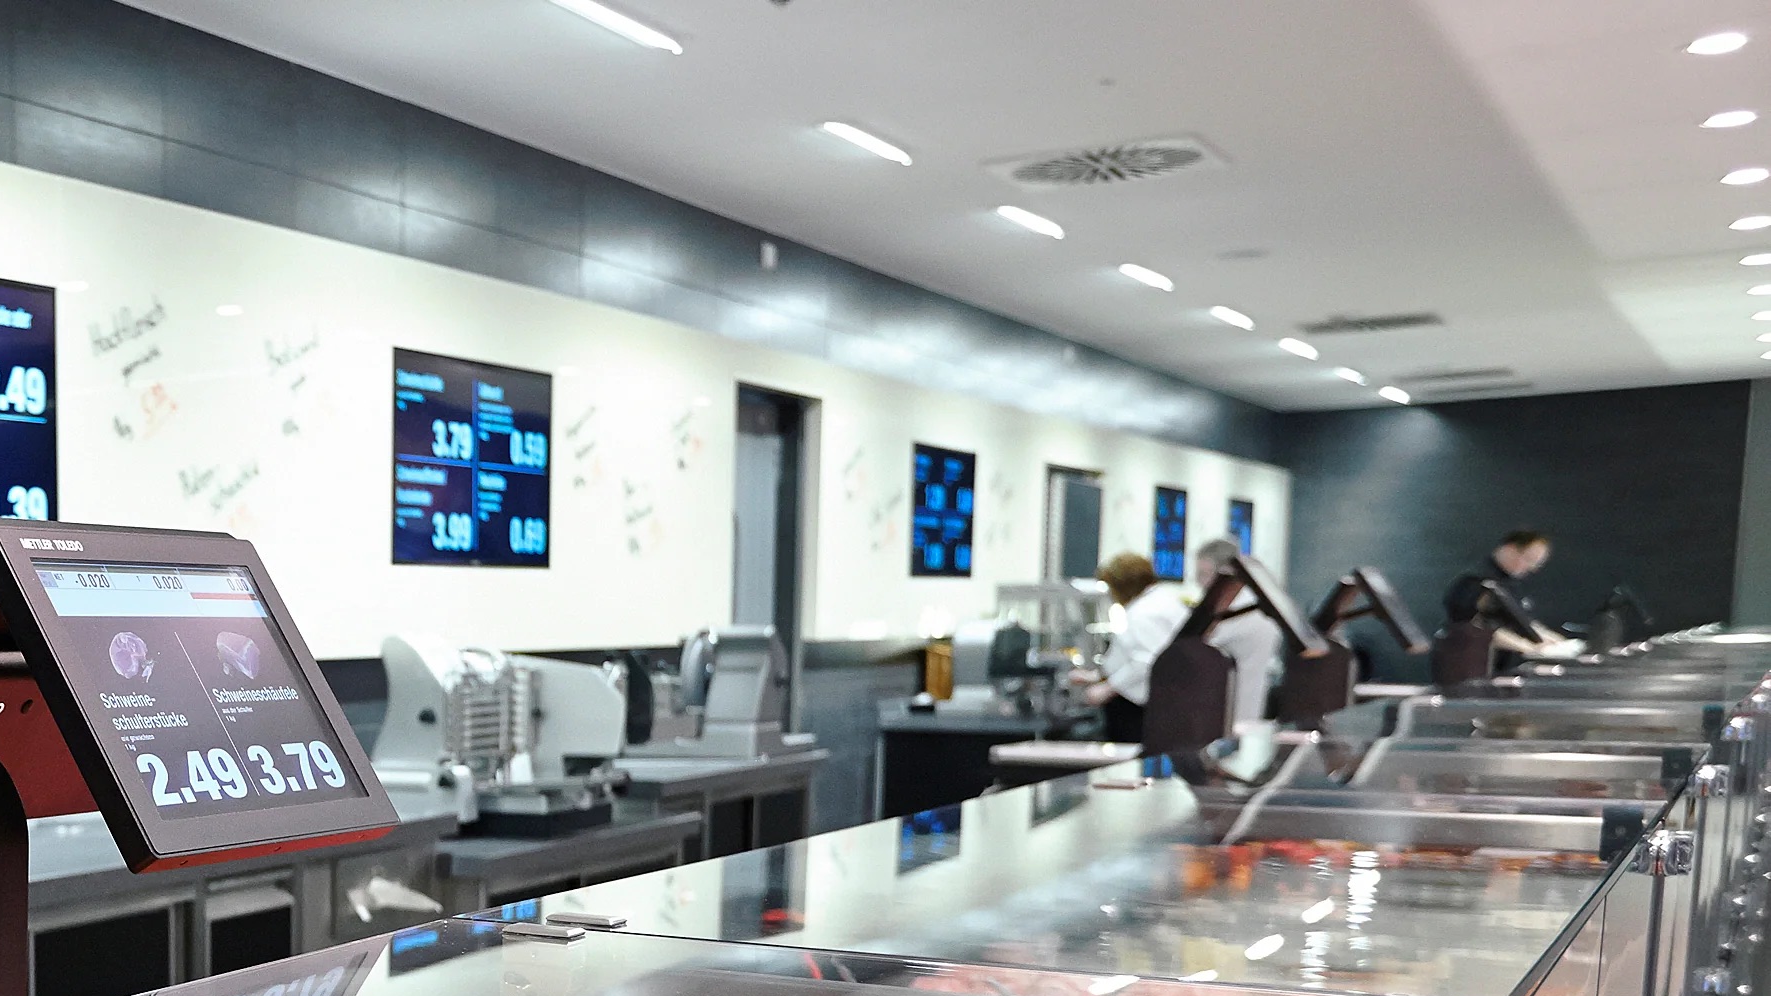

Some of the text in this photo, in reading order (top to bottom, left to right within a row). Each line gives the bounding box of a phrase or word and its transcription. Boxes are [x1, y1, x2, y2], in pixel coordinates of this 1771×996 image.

[19, 537, 84, 552] METTLER TOLEDO
[153, 575, 183, 590] 0.020
[226, 578, 249, 592] 0.00
[99, 692, 157, 709] Schweine-
[212, 686, 299, 704] Schweineschäufele
[112, 711, 189, 731] schulterstücke
[247, 740, 346, 795] 3.79
[136, 748, 248, 807] 2.49
